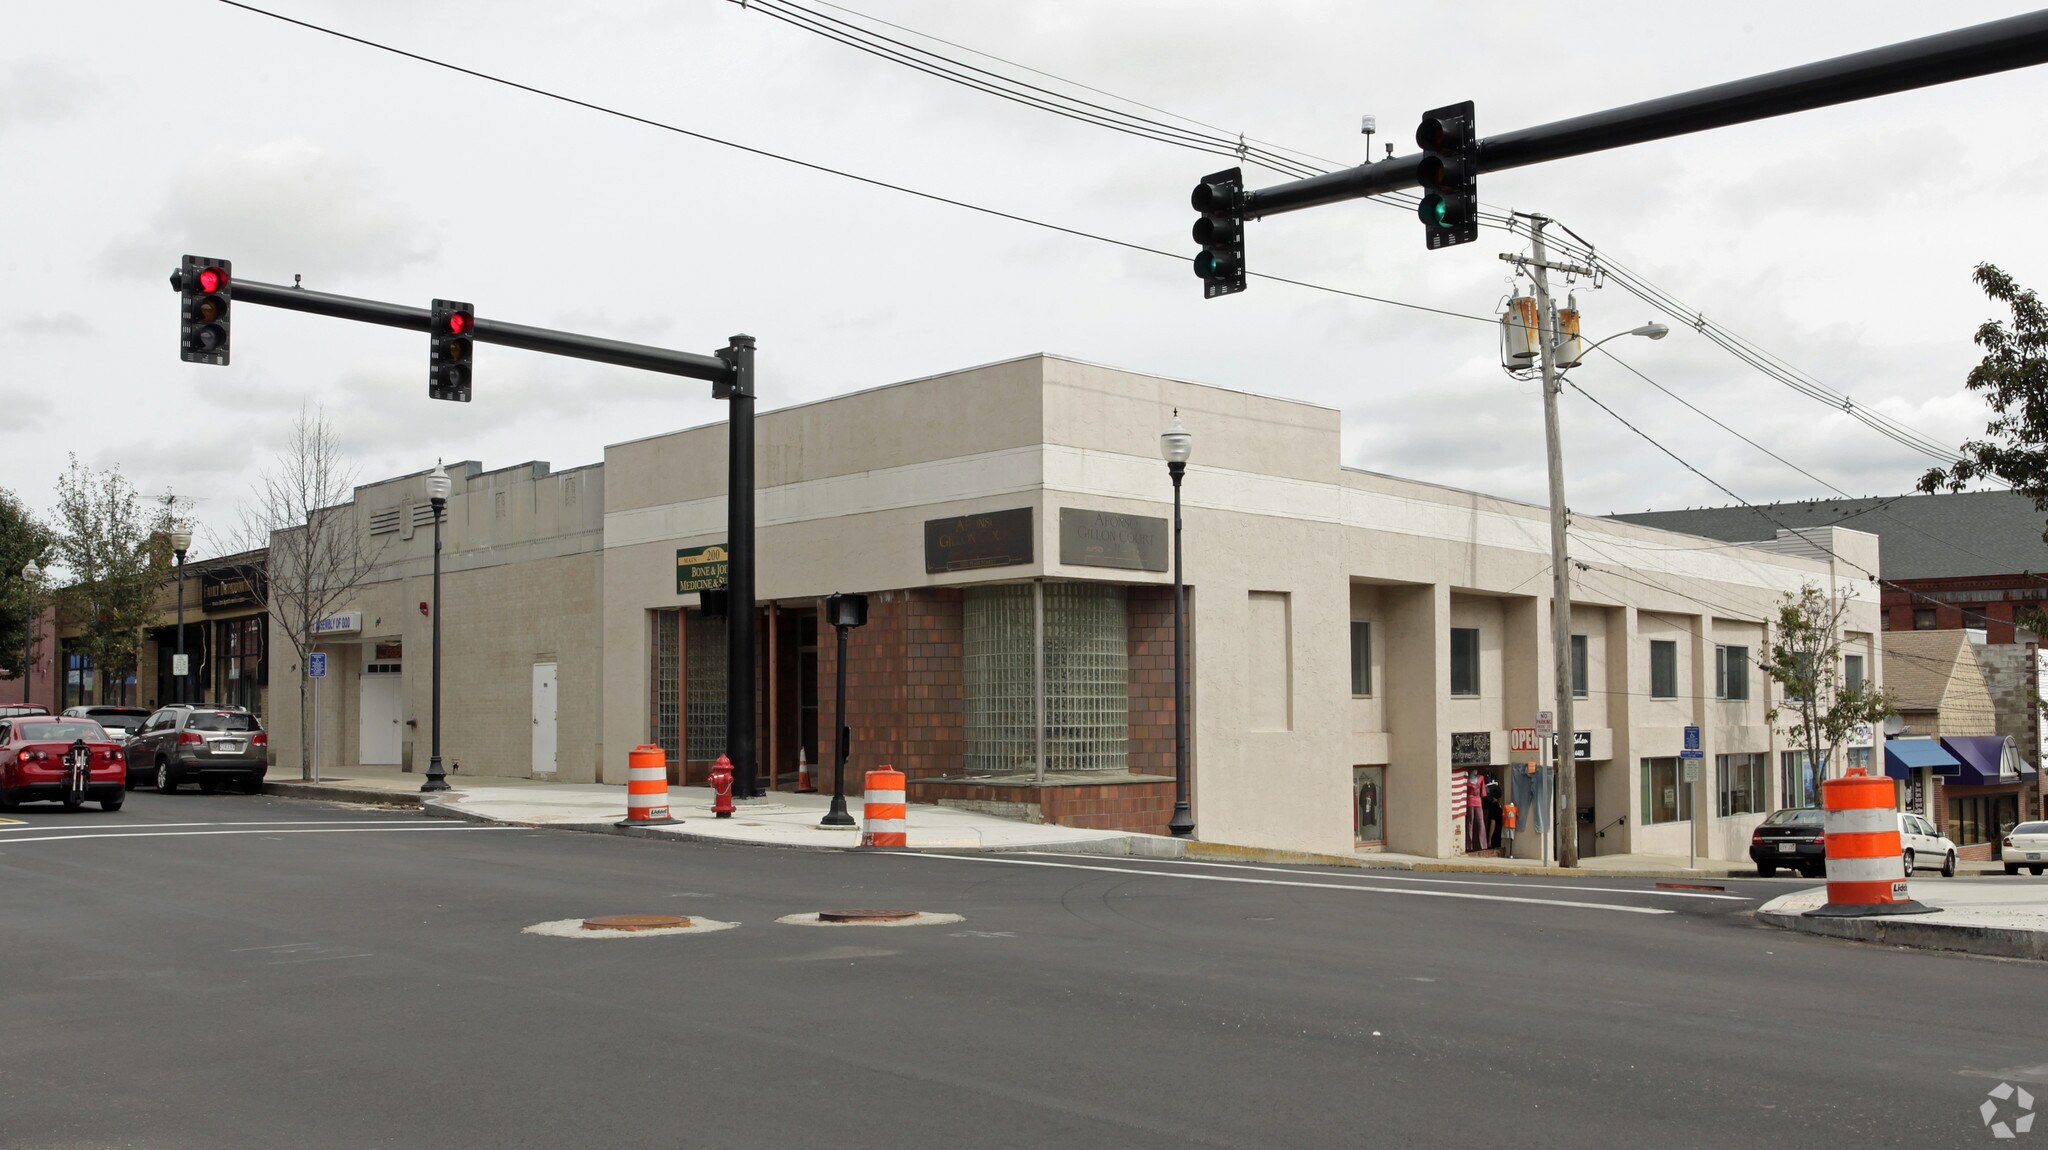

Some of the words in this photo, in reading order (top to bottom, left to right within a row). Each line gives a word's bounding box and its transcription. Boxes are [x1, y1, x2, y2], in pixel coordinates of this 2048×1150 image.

[707, 549, 719, 561] 200
[691, 566, 710, 577] BONE
[710, 566, 716, 576] &
[680, 579, 712, 591] MEDICINE
[712, 578, 718, 588] &
[335, 618, 342, 630] OF
[342, 616, 351, 629] GOD
[1511, 730, 1539, 749] OPEN
